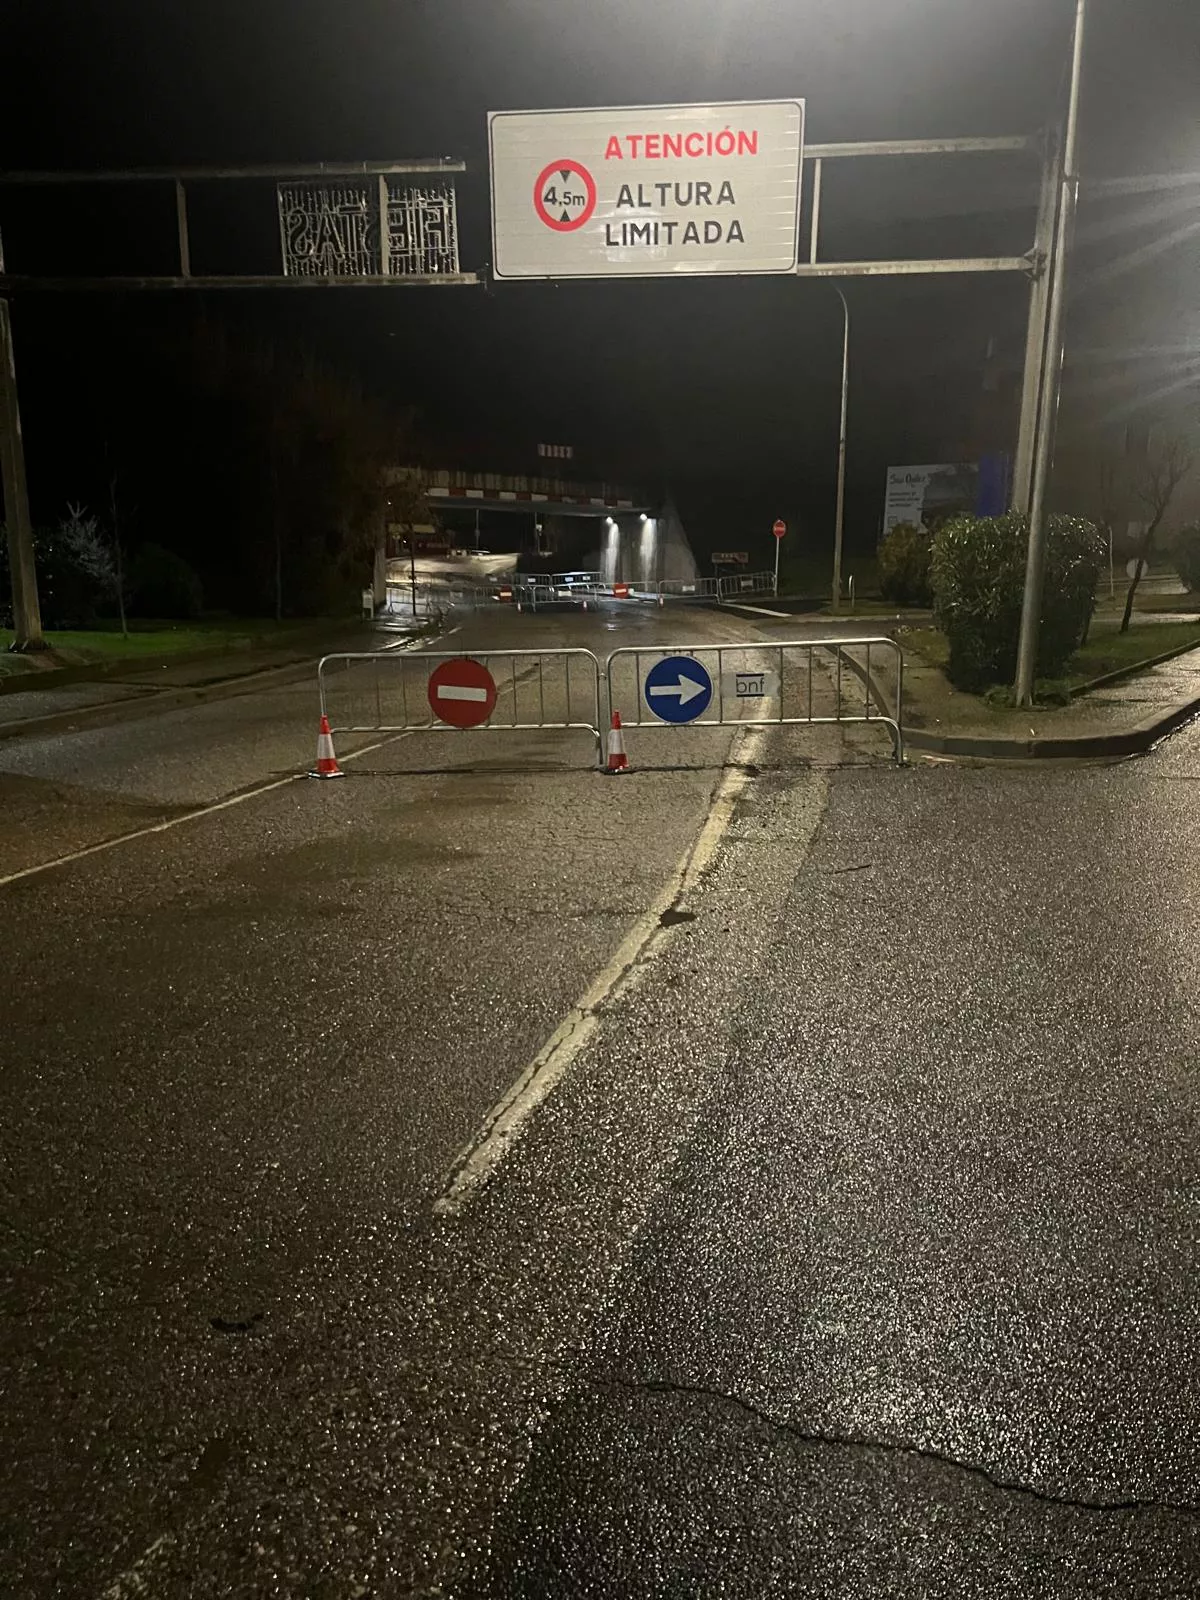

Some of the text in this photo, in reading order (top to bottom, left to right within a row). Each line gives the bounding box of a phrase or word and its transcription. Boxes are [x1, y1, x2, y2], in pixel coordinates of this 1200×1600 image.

[604, 125, 759, 160] ATENCIÓN
[543, 186, 586, 208] 4,5m
[615, 180, 736, 209] ALTURA
[604, 219, 745, 247] LIMITADA
[735, 678, 765, 693] bnf
